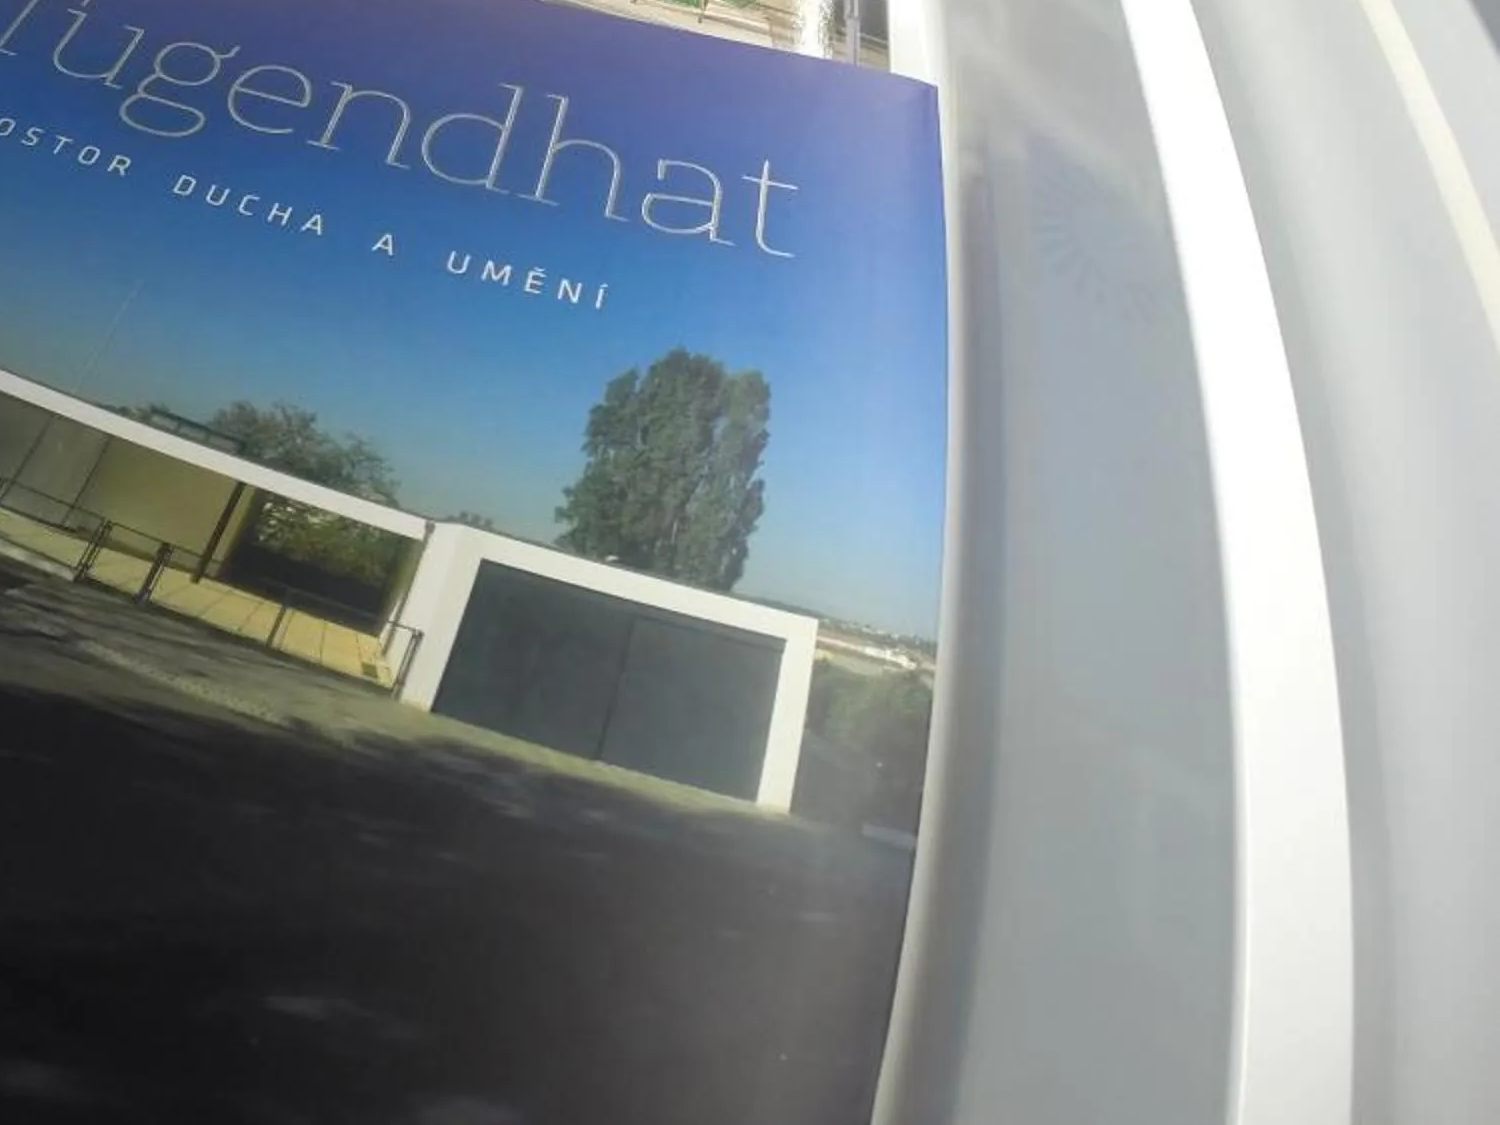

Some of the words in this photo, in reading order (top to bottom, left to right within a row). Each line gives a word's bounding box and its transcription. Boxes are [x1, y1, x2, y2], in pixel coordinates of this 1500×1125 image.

[171, 175, 325, 236] DUCHA
[372, 232, 394, 255] A
[446, 250, 608, 309] UMĚNÍ
